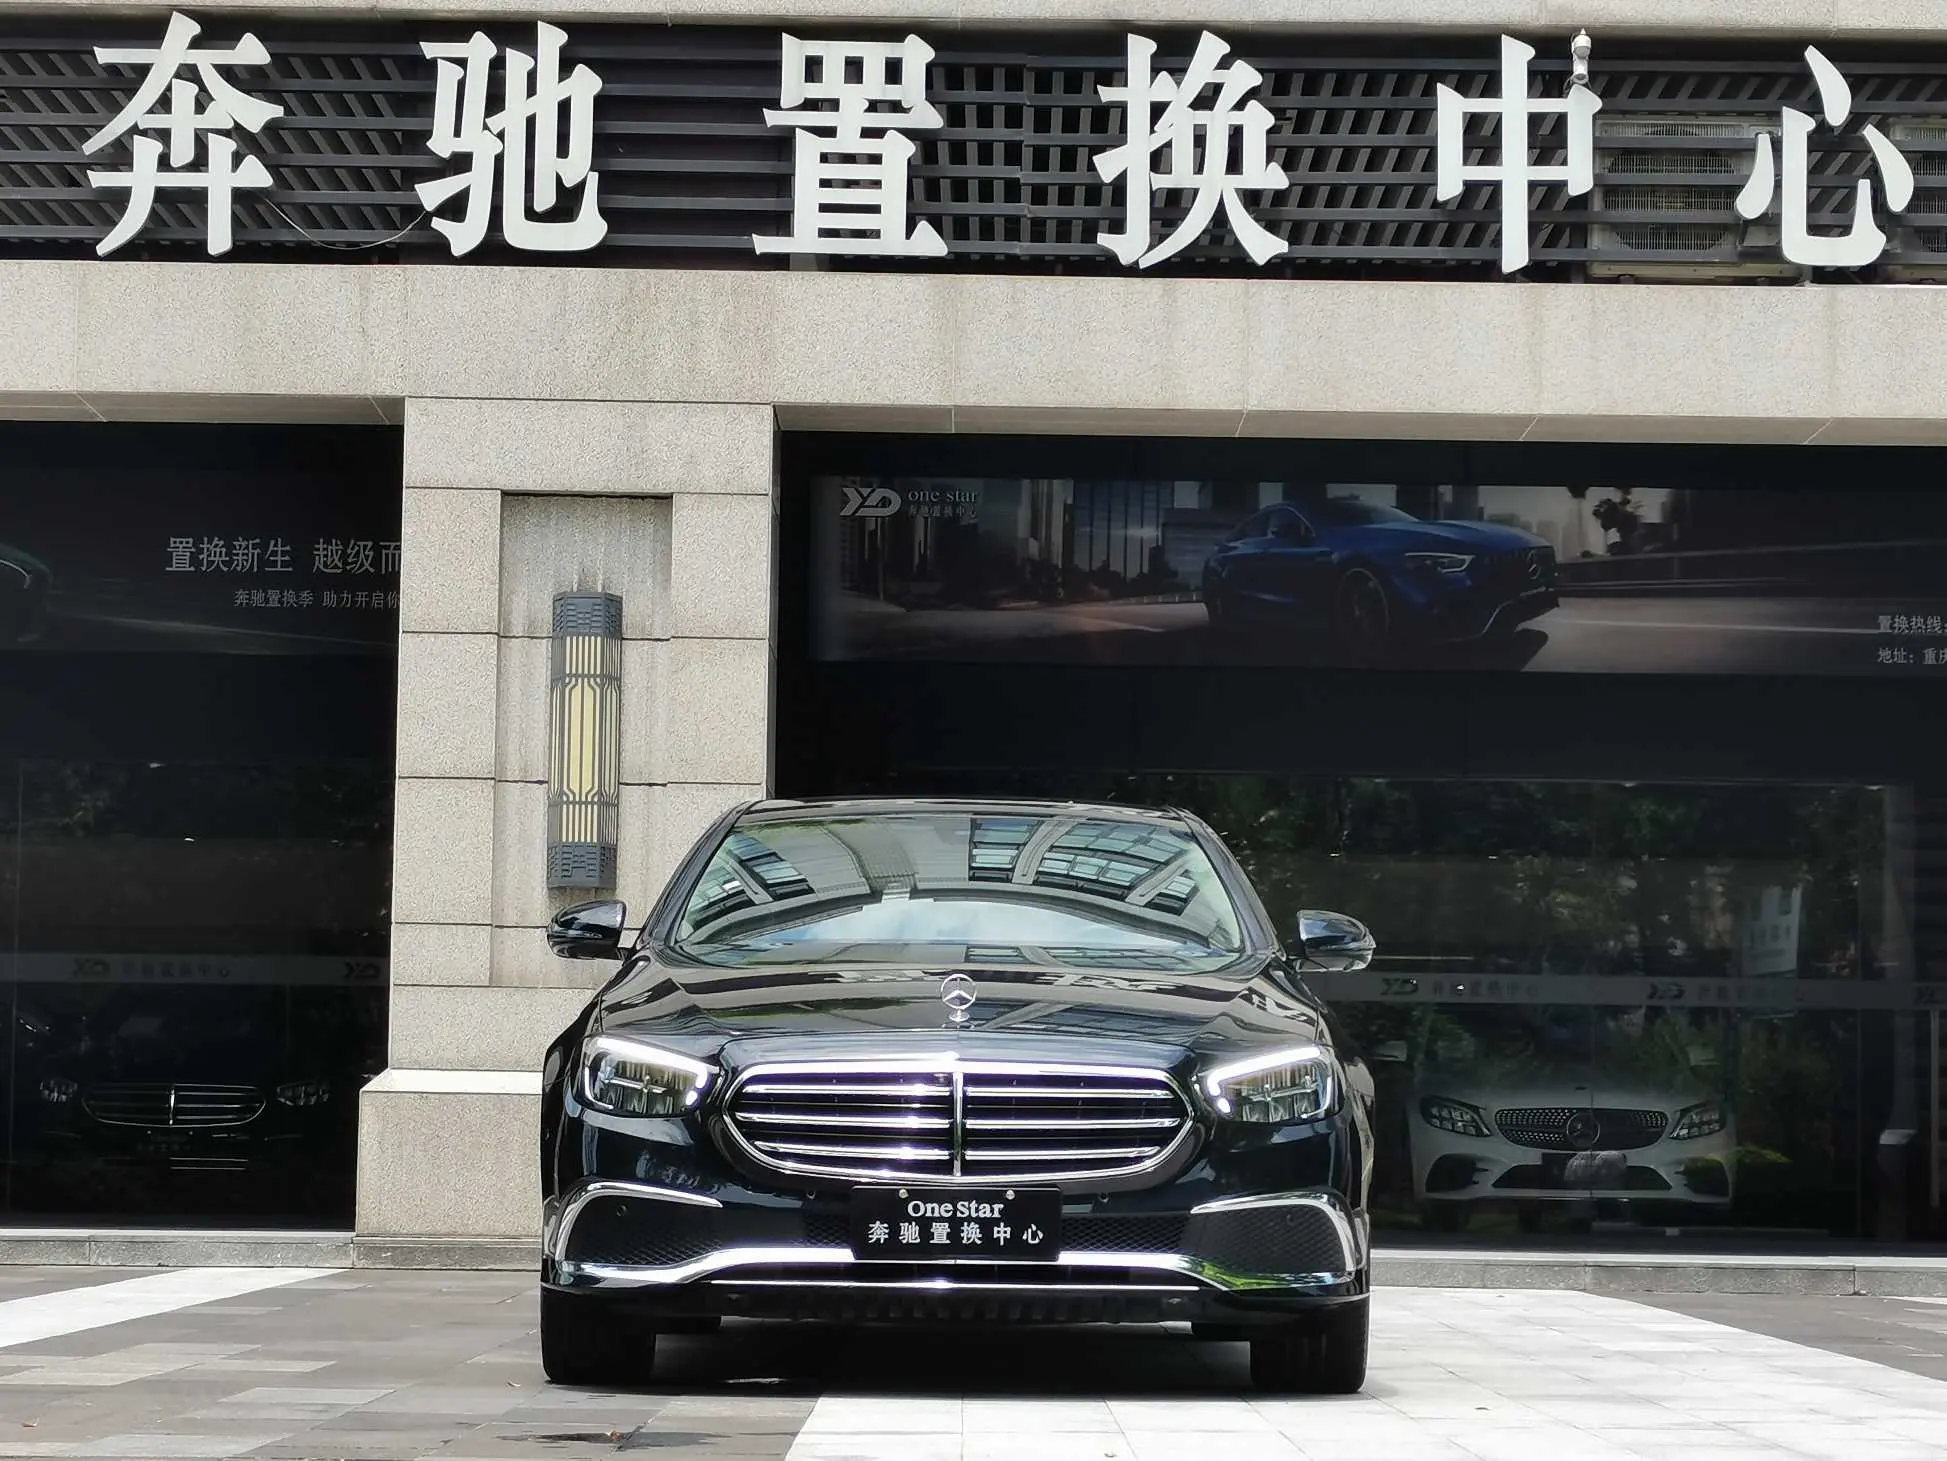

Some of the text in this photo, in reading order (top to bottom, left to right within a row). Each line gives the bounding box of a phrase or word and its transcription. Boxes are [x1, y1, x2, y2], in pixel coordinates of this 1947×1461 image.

[81, 11, 1914, 274] 奔驰置换中心
[908, 489, 977, 502] one star
[165, 537, 400, 574] 置换新生 越级而
[233, 589, 313, 608] 奔驰置换季
[907, 1200, 1004, 1218] One Star
[868, 1220, 1044, 1246] 奔驰置换中心
